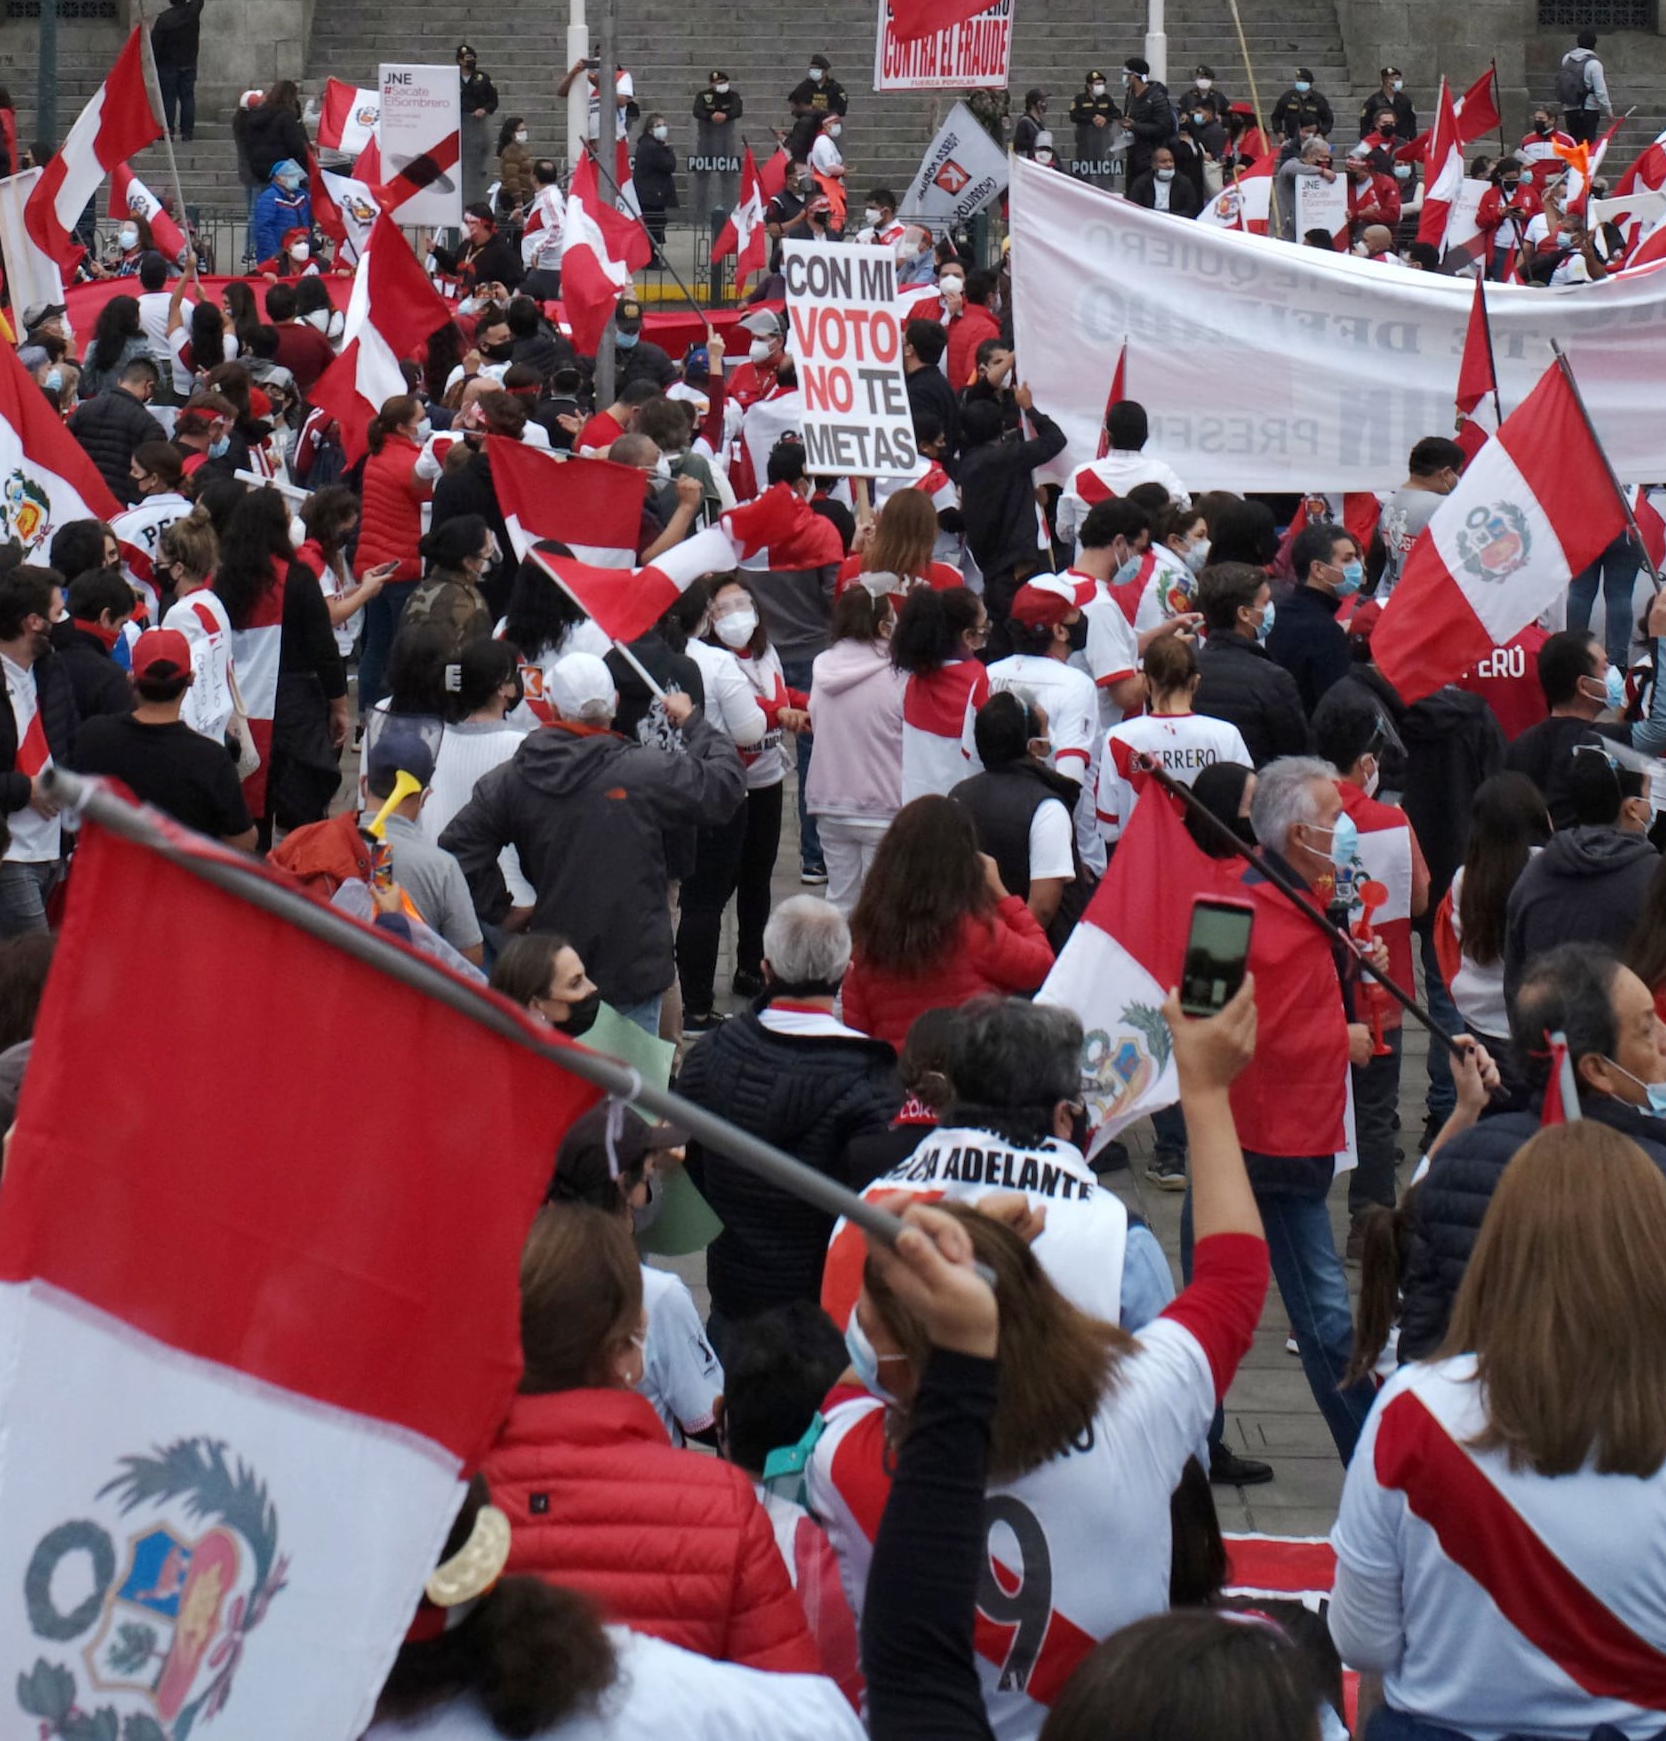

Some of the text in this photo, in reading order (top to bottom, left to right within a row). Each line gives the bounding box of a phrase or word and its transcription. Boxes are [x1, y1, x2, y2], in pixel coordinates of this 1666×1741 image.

[956, 19, 1008, 77] FRAUDE
[384, 73, 412, 85] JNE
[786, 254, 895, 302] CON MI
[789, 305, 899, 364] VOTO
[802, 364, 907, 416] NO TE
[803, 422, 917, 471] METAS
[1465, 644, 1526, 678] ERÚ
[942, 1147, 1095, 1202] ADELANTE
[978, 1494, 1053, 1693] 9
